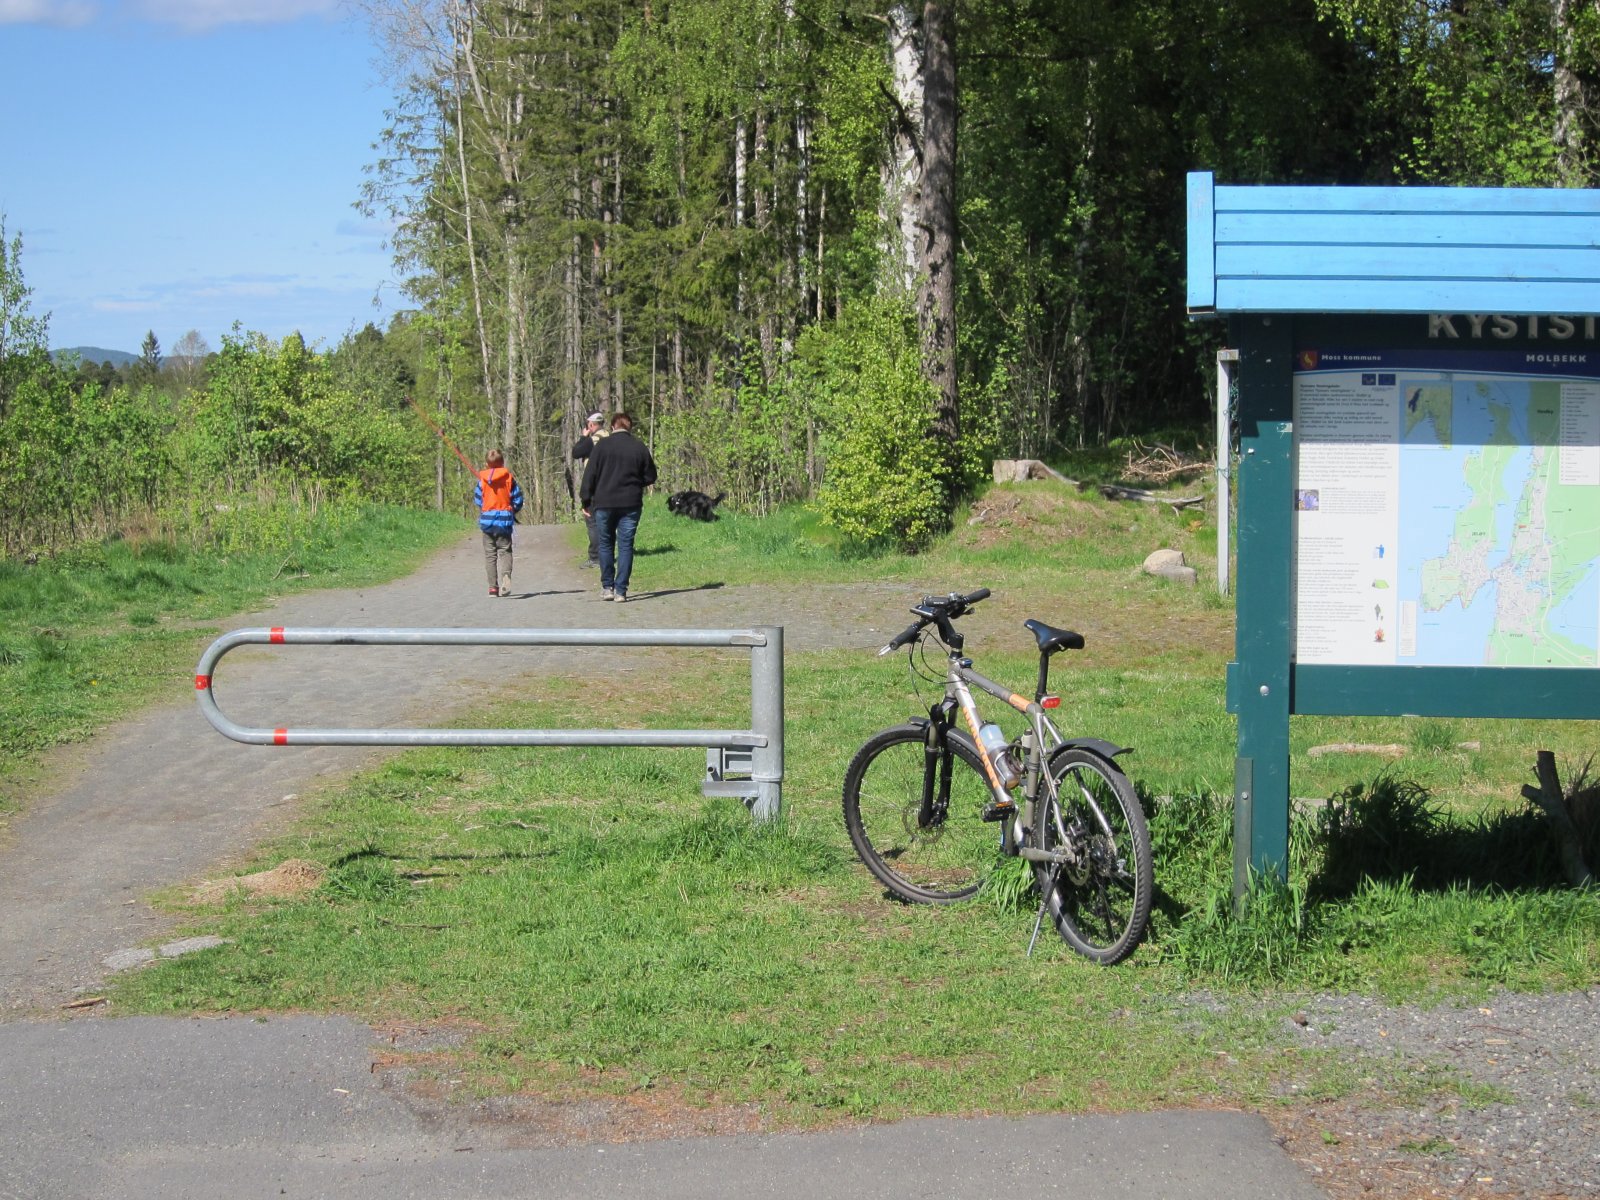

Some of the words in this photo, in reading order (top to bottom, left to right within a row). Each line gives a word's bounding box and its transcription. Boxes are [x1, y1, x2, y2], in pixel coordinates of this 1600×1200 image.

[1321, 353, 1341, 361] Moss
[1343, 353, 1382, 361] kommune
[1526, 354, 1587, 363] MOLBEKK
